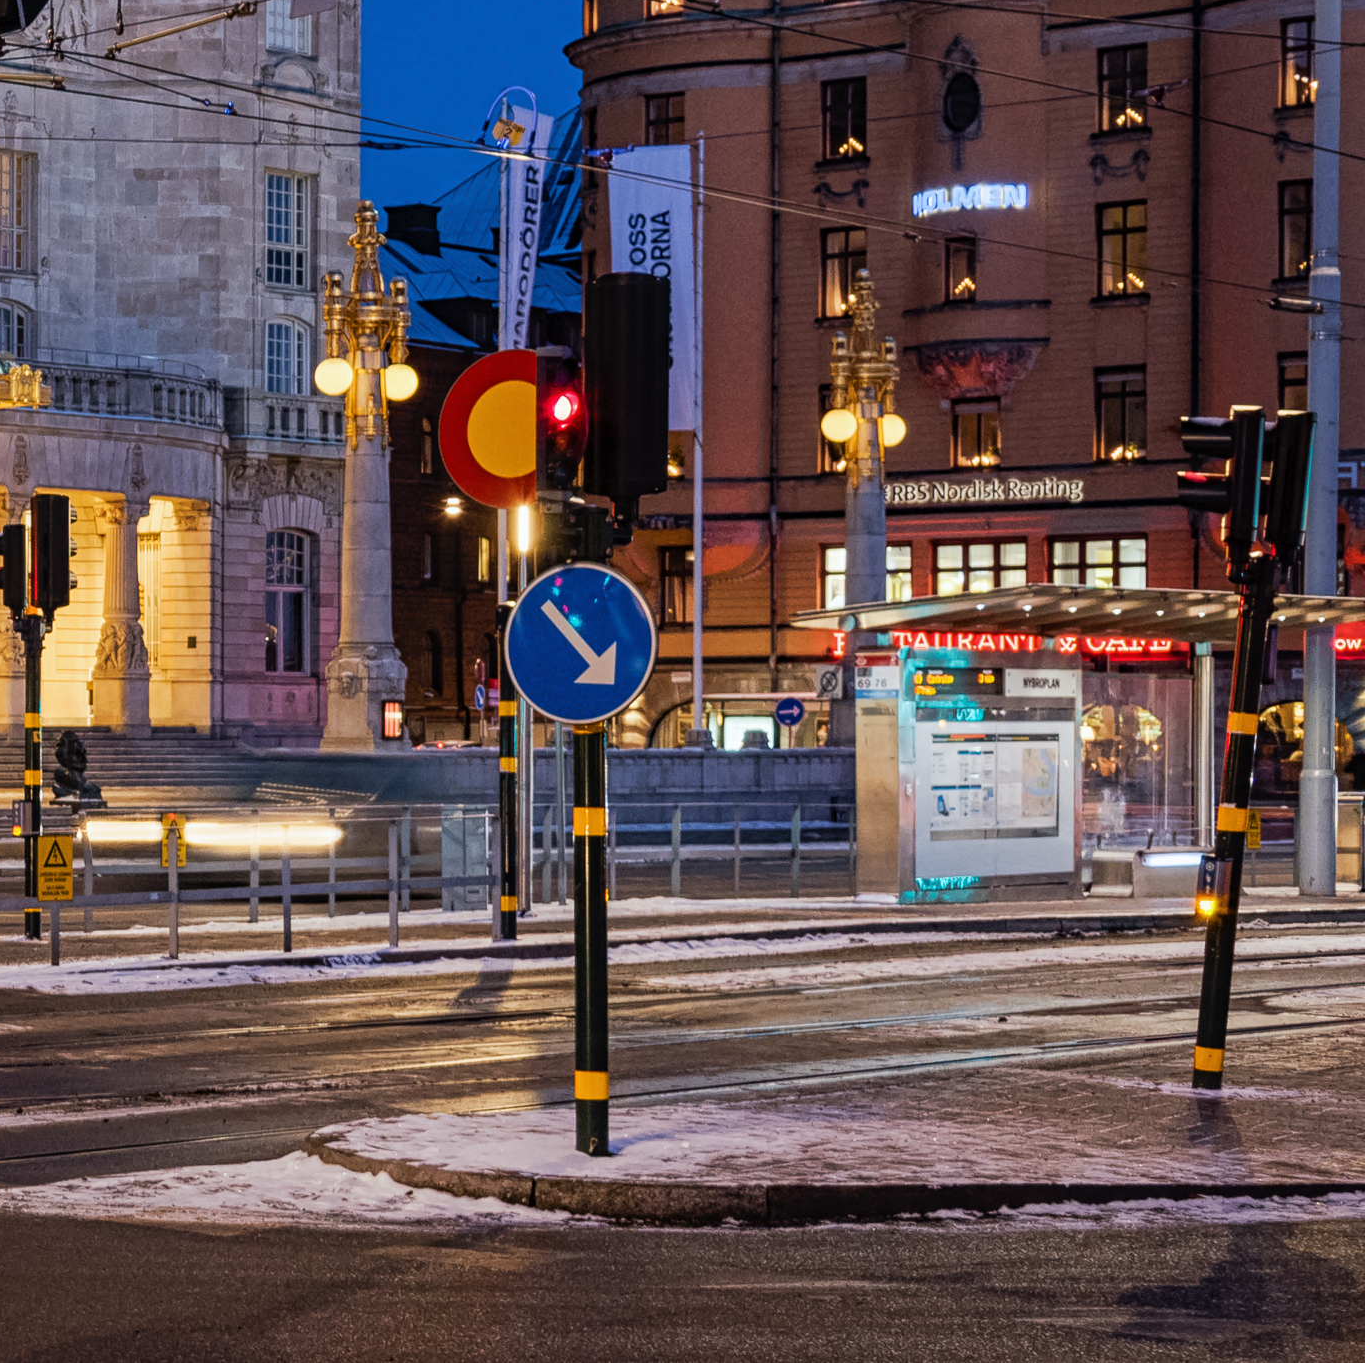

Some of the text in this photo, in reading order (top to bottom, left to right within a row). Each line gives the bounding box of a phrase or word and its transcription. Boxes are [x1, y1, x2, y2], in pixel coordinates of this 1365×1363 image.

[503, 127, 513, 139] 2
[912, 183, 1028, 217] HOLMEN
[628, 212, 647, 267] OSS
[892, 476, 1084, 504] RBS Nordisk Renting
[1023, 677, 1060, 688] NYBROPLAN
